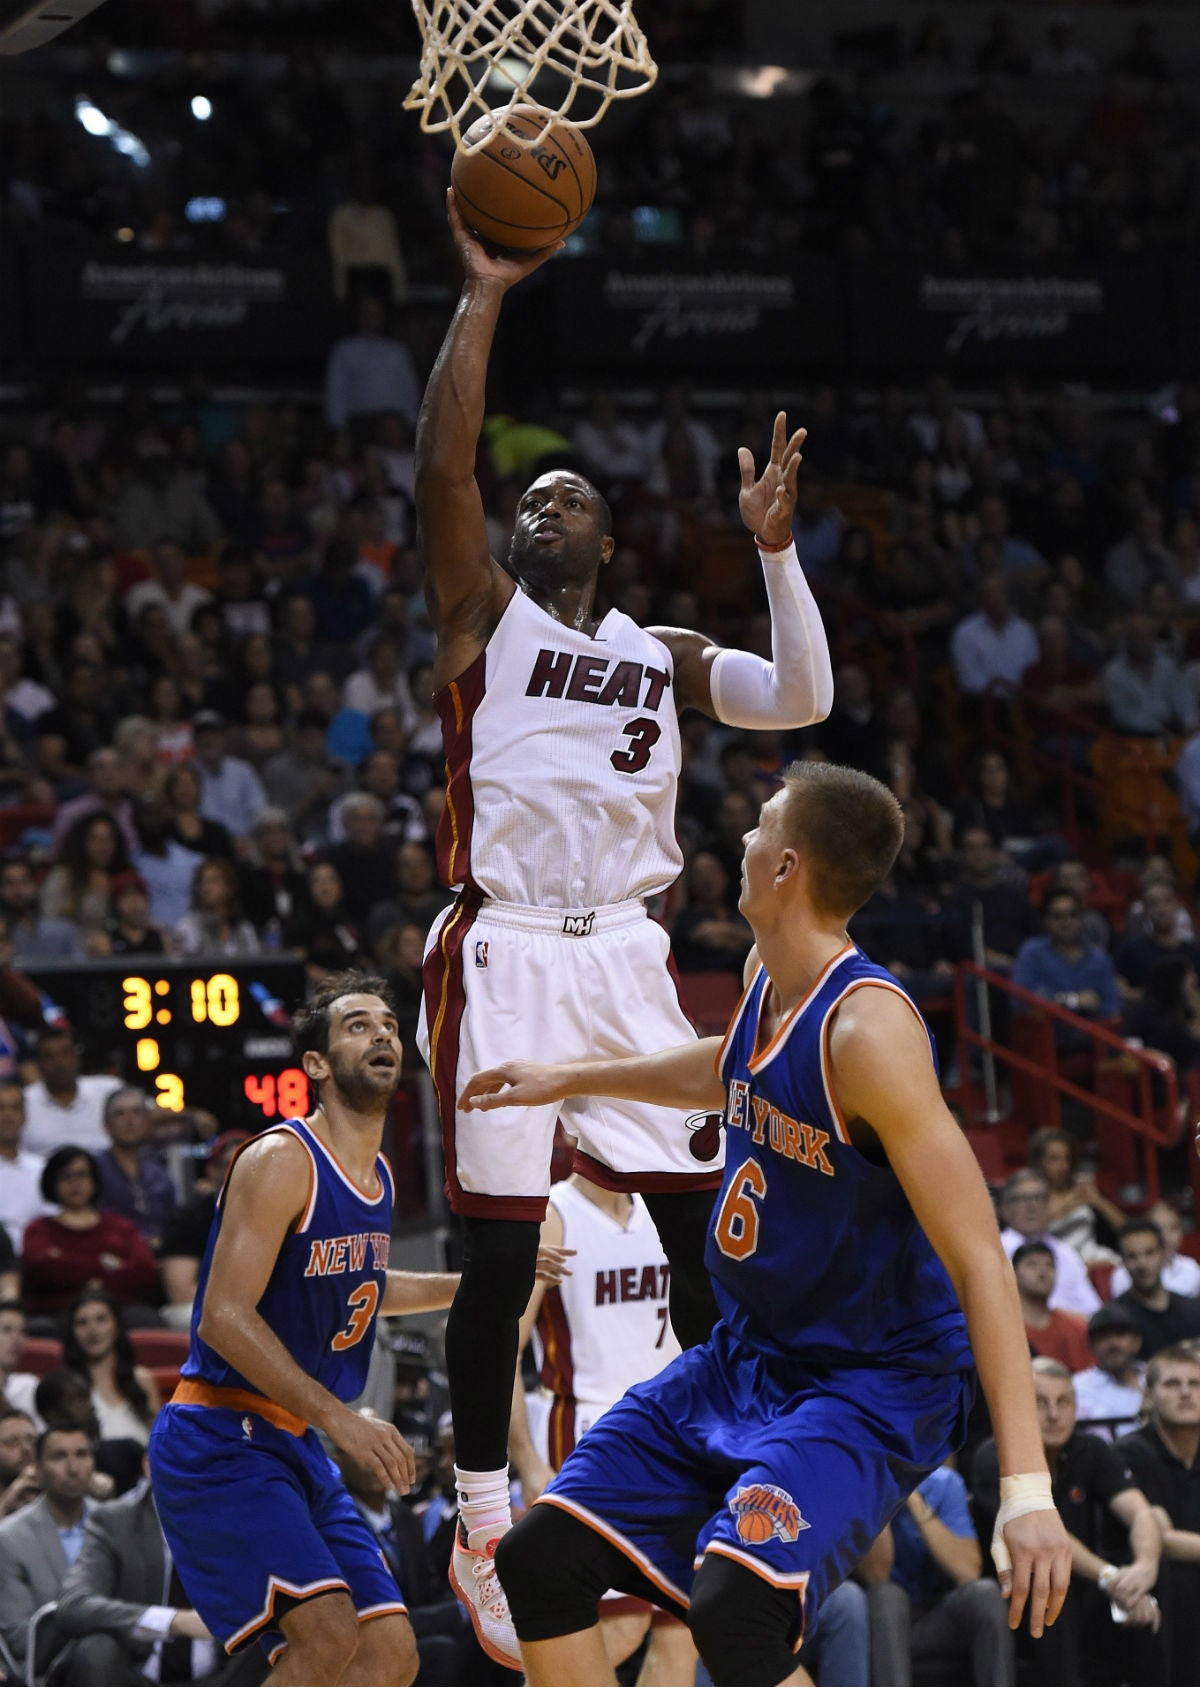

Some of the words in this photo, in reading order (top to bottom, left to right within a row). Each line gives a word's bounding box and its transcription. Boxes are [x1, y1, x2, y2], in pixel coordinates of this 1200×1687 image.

[525, 648, 671, 712] HEAT
[609, 716, 662, 776] 3
[122, 974, 240, 1030] 3:10
[244, 1068, 309, 1119] 48
[751, 1095, 834, 1176] YORK
[714, 1156, 768, 1262] 6
[304, 1233, 369, 1277] NEW
[595, 1263, 671, 1307] HEAT
[331, 1280, 379, 1352] 3
[655, 1307, 669, 1350] 7
[730, 1486, 800, 1540] KNICKS
